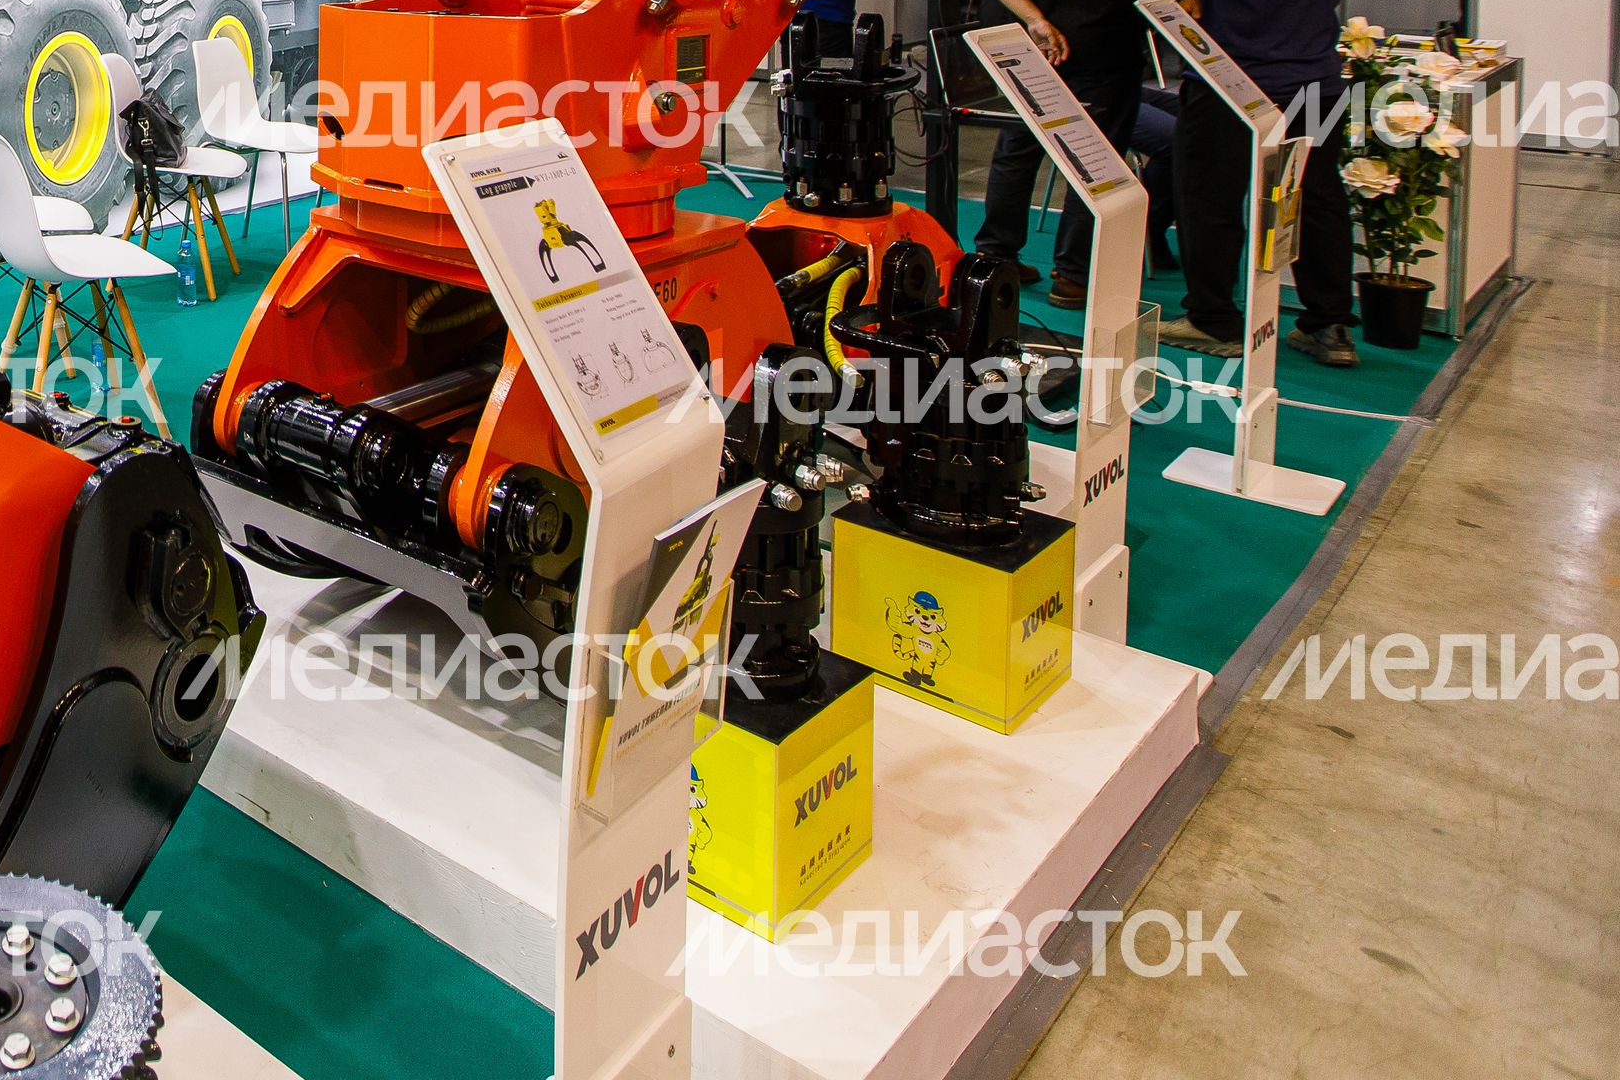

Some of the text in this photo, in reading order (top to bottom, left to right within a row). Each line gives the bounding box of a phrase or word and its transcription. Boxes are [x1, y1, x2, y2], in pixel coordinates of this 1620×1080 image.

[1252, 322, 1275, 352] XUVOL
[1083, 453, 1125, 508] XUVOL
[1022, 590, 1064, 643] XUVOL
[793, 754, 858, 828] XUVOL
[575, 850, 680, 982] XUVOL
